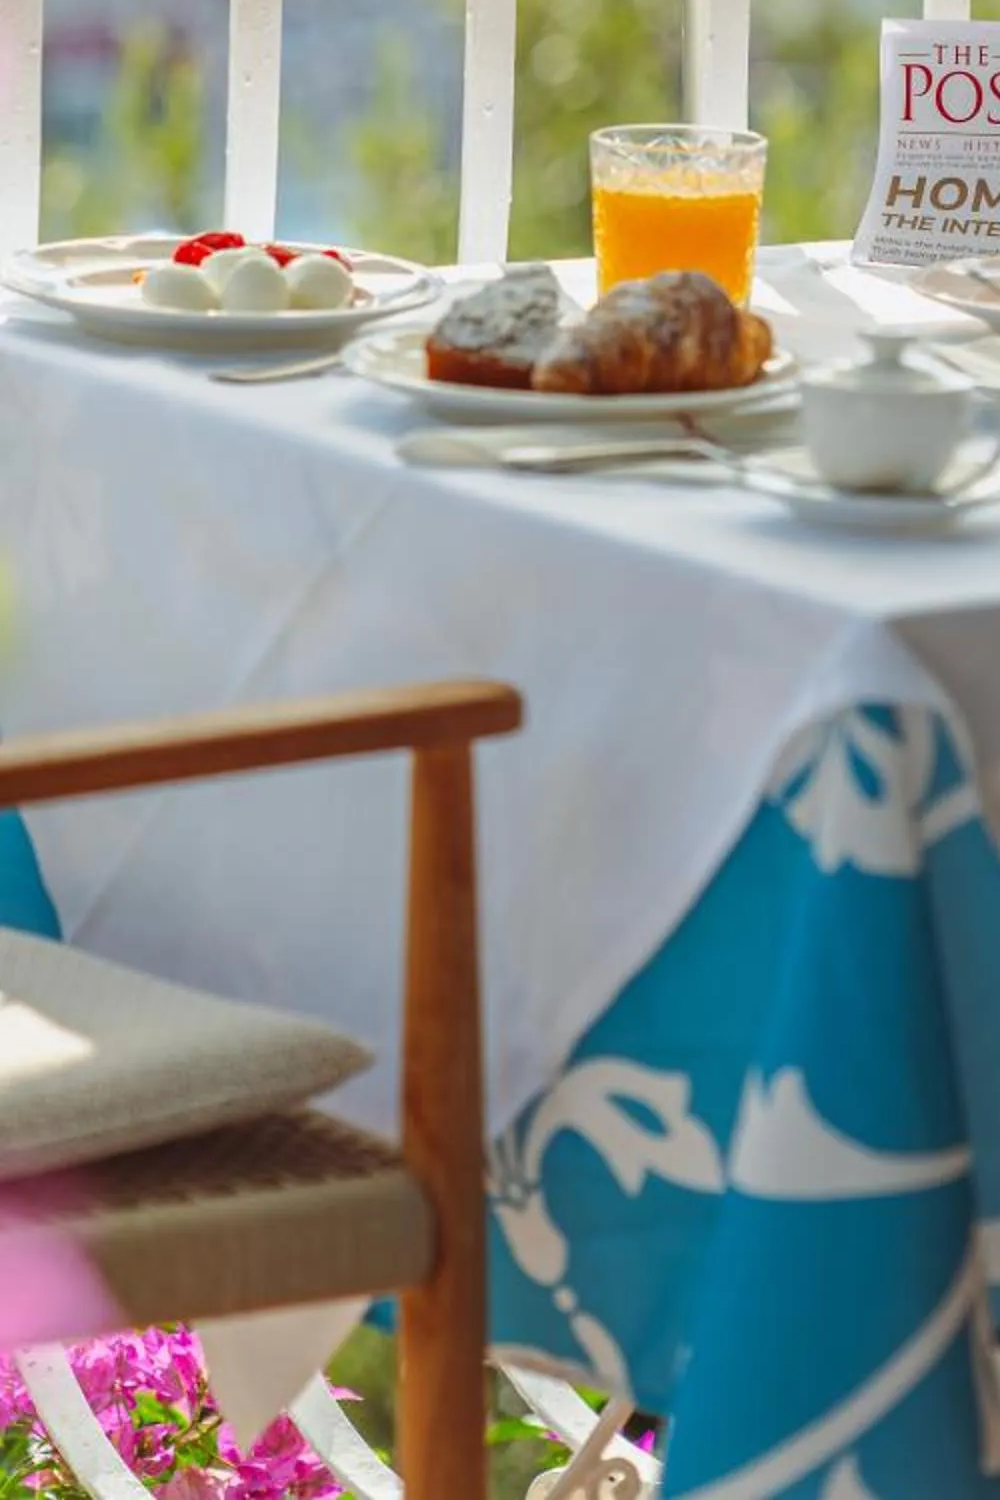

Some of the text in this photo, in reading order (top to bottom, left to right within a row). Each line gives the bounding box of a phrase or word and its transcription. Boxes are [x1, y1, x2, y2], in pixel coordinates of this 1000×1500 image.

[931, 43, 990, 67] THE
[897, 139, 942, 151] NEWS
[881, 212, 937, 231] THE
